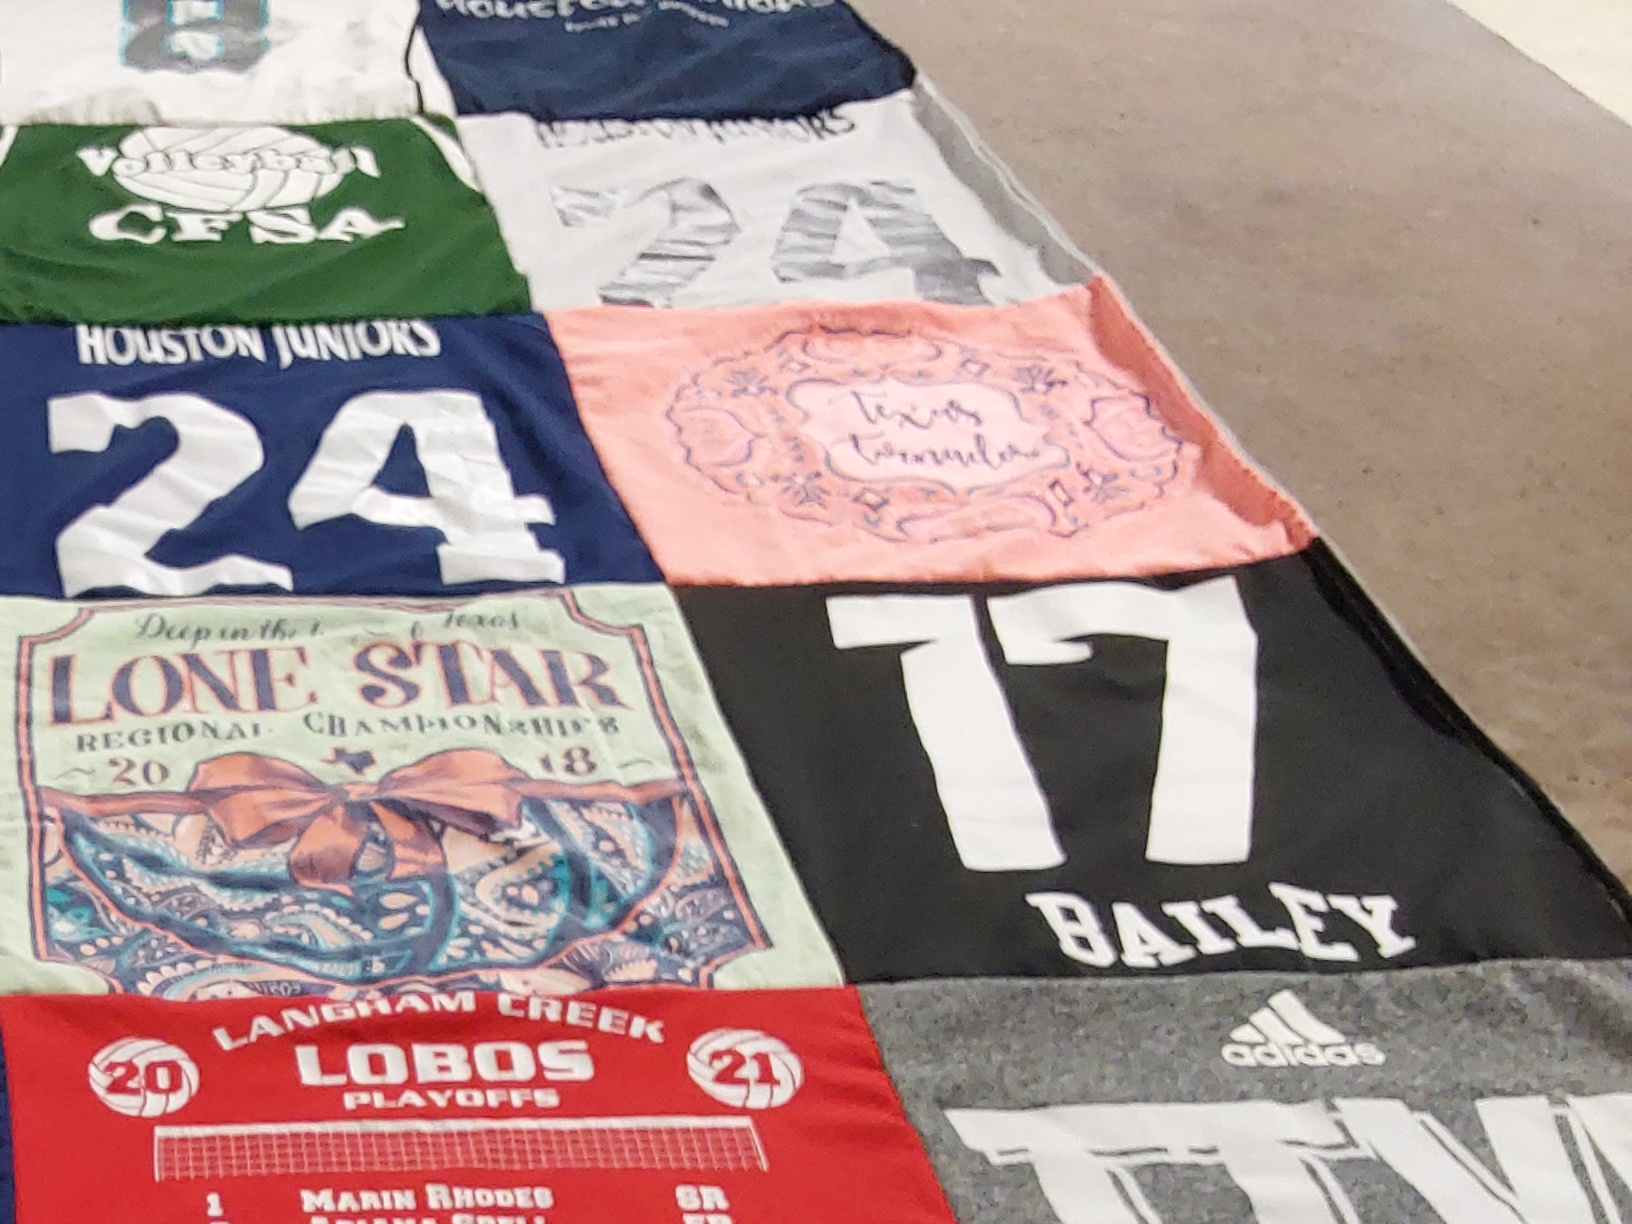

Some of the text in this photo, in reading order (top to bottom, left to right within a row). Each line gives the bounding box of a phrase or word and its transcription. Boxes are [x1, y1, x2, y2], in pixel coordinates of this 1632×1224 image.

[88, 203, 406, 244] CFSA
[77, 321, 441, 370] HOUSTON JUNIORS
[48, 388, 566, 599] 24
[48, 637, 636, 728] LONE STAR
[76, 719, 272, 755] REGIONAL
[108, 756, 170, 788] 20
[1025, 881, 1418, 969] BAILEY
[212, 992, 667, 1052] LANGHAM CREEK
[295, 1040, 597, 1088] LOBOS
[711, 1049, 782, 1084] 21
[1221, 1042, 1386, 1068] adidas
[109, 1060, 183, 1096] 20
[342, 1087, 561, 1111] PLAYOFFS
[206, 1192, 223, 1217] 1
